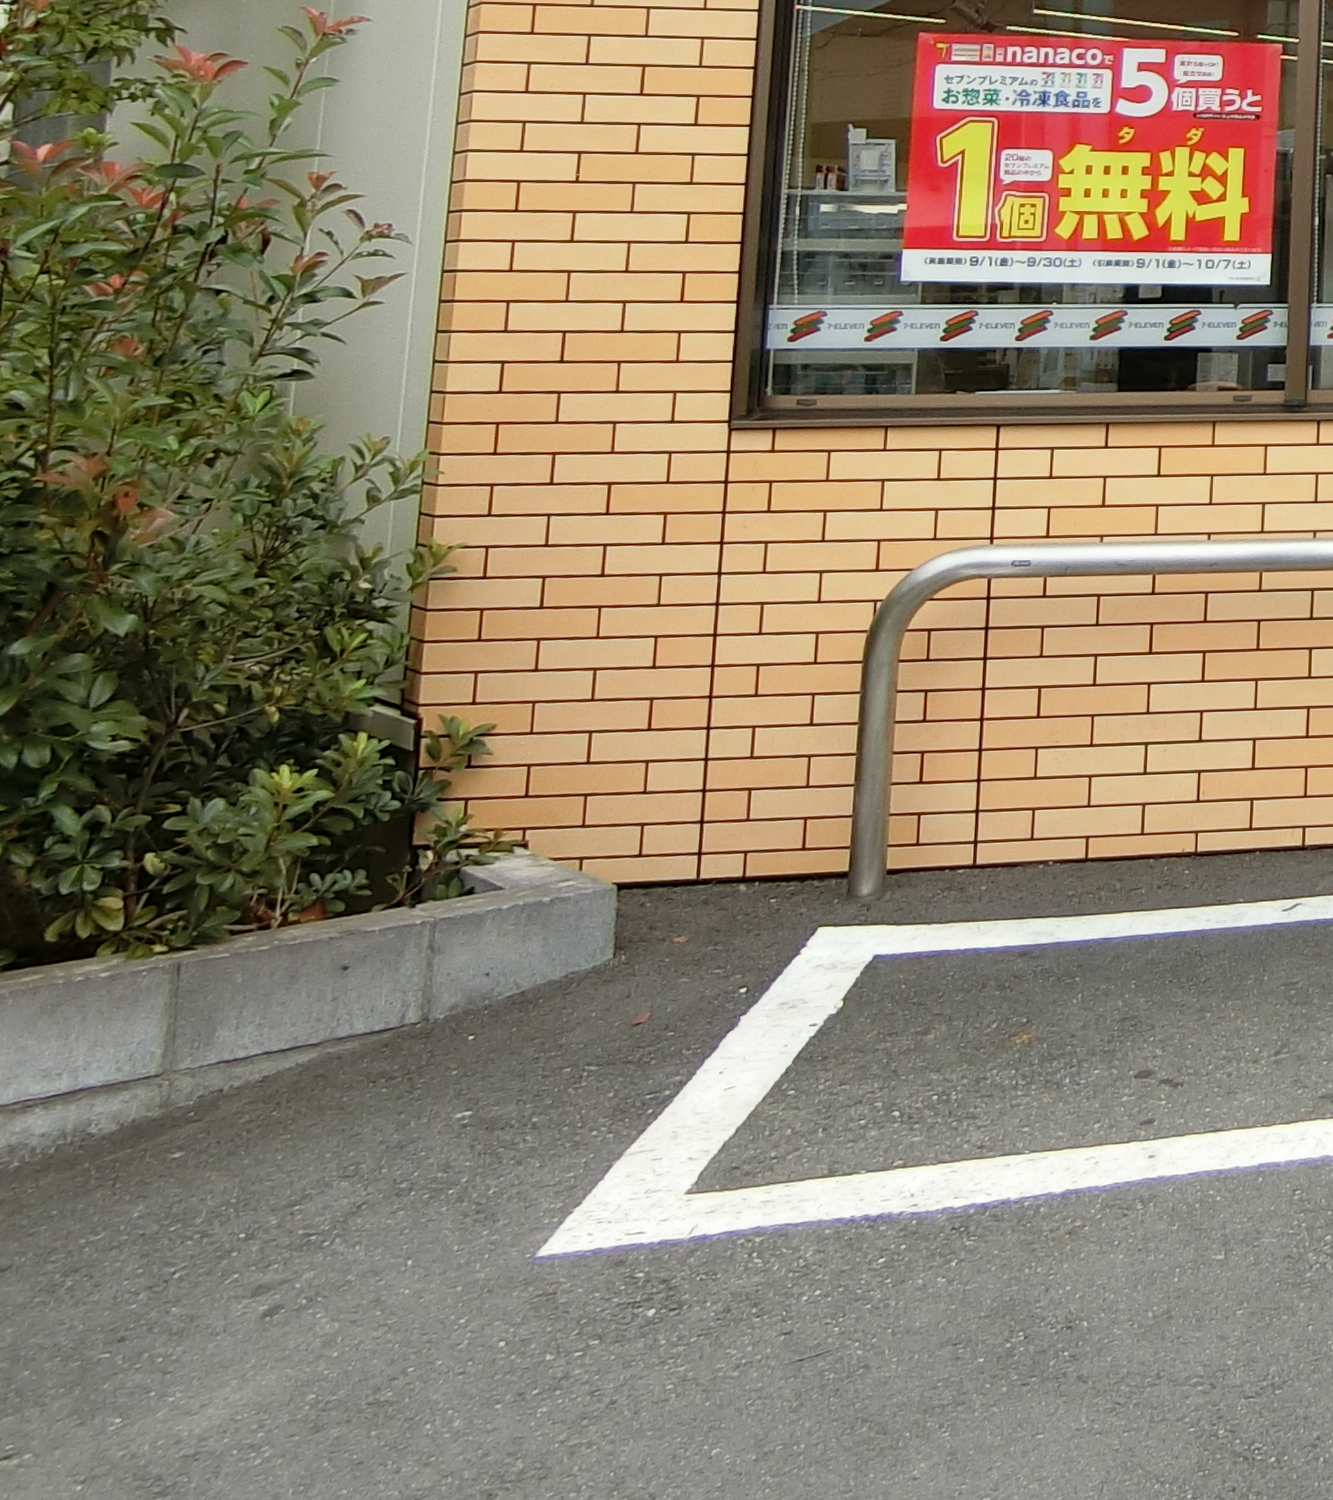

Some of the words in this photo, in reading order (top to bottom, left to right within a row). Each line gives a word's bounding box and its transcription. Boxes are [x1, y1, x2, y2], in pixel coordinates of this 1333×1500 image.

[944, 74, 1038, 87] セブンプレミアムの
[941, 87, 1103, 109] お惣菜・冷凍食品を
